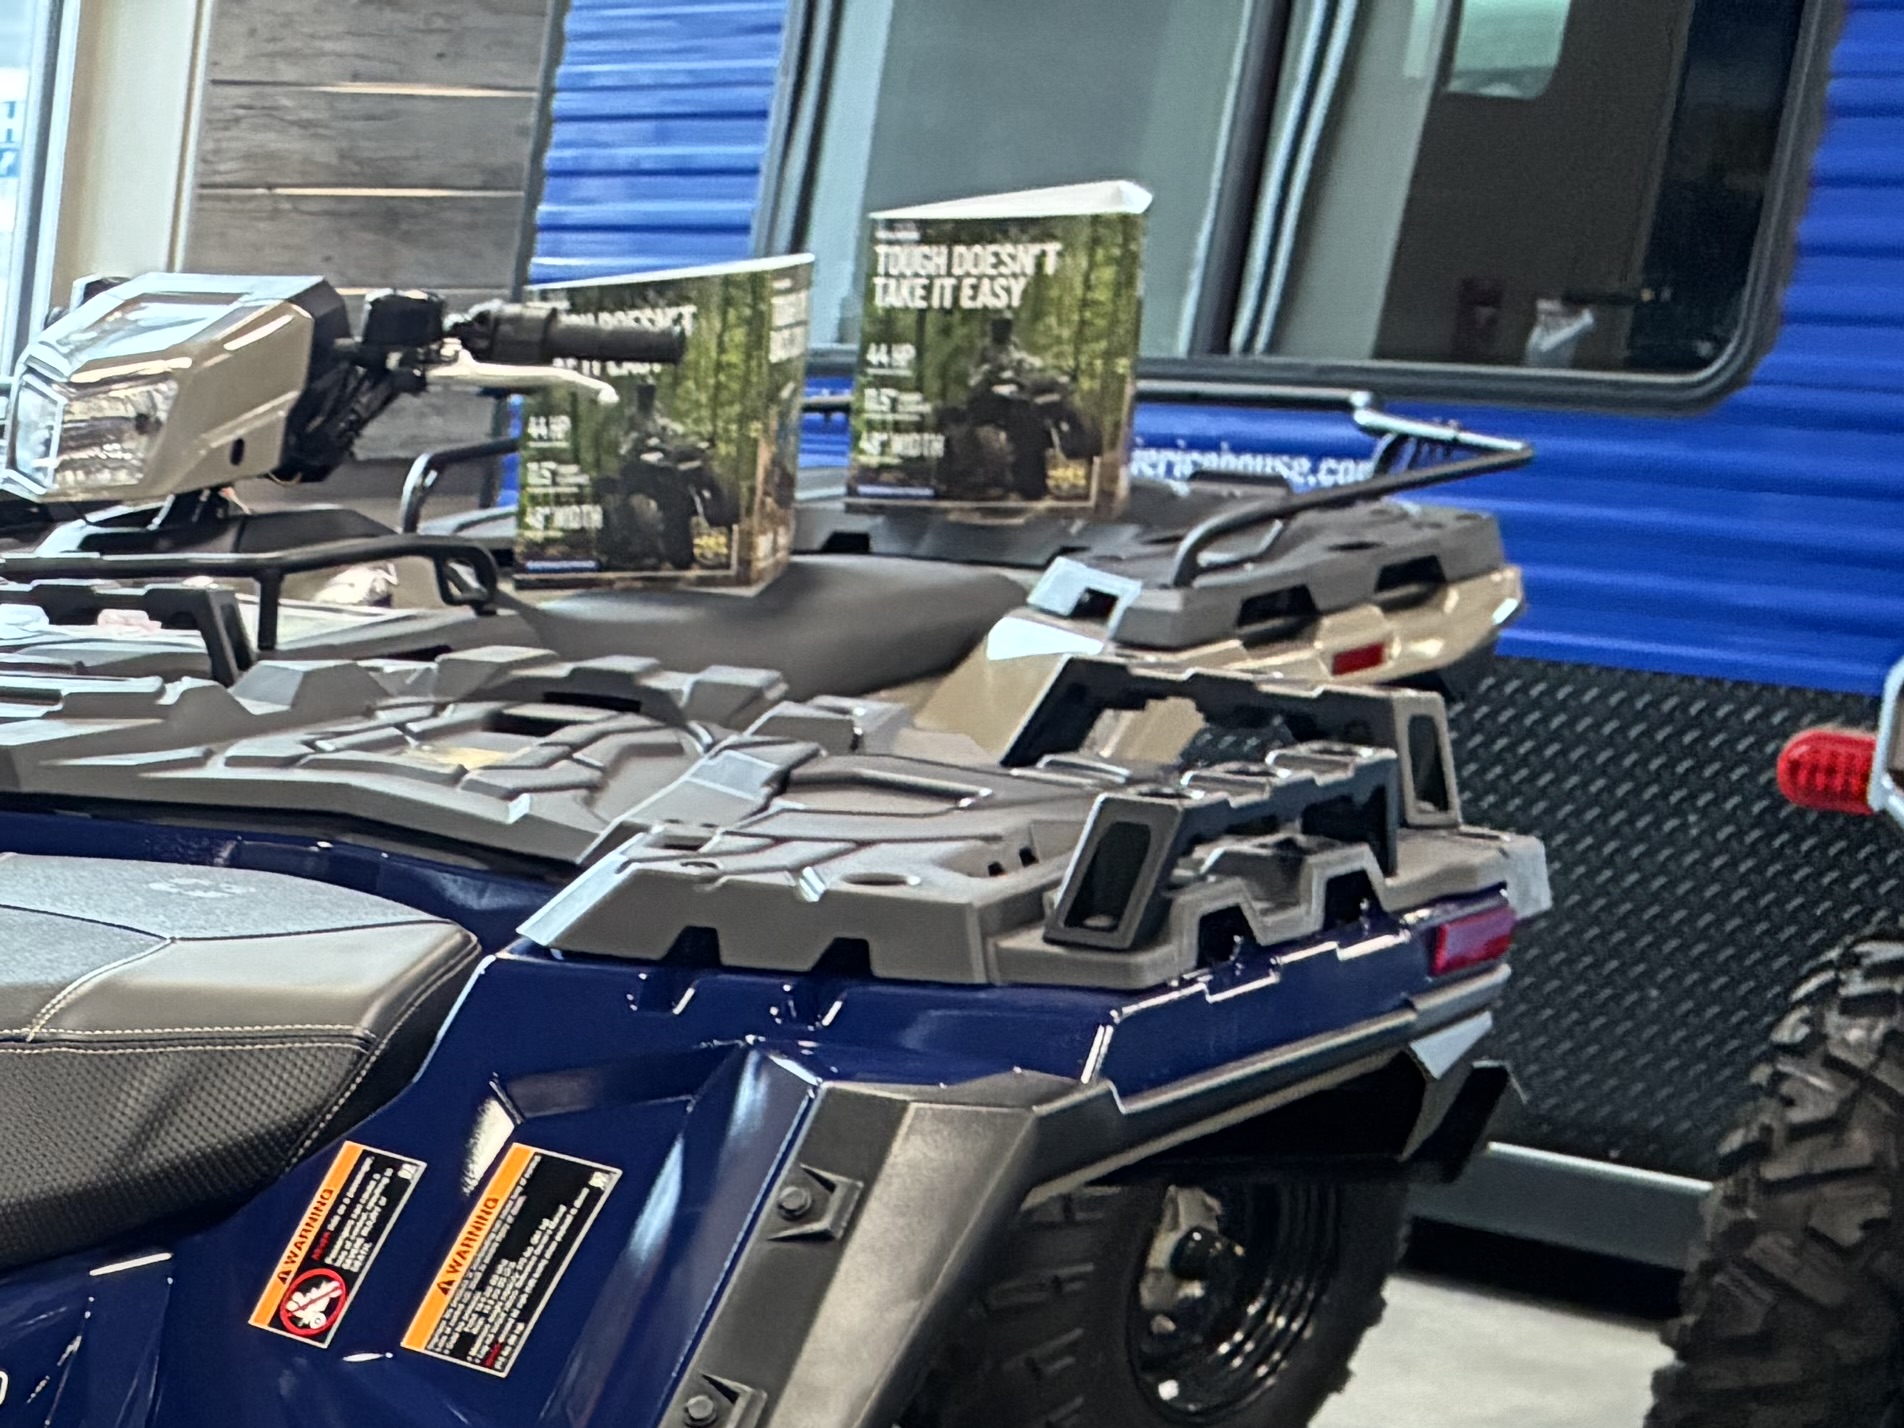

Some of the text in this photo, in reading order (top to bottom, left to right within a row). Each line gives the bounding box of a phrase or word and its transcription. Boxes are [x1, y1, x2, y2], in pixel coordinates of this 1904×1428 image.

[875, 242, 1063, 276] TOUGH DOESN'T
[873, 276, 1030, 309] TAKE IT EASY
[285, 1188, 333, 1264] WARNING
[447, 1196, 500, 1275] WARNING
